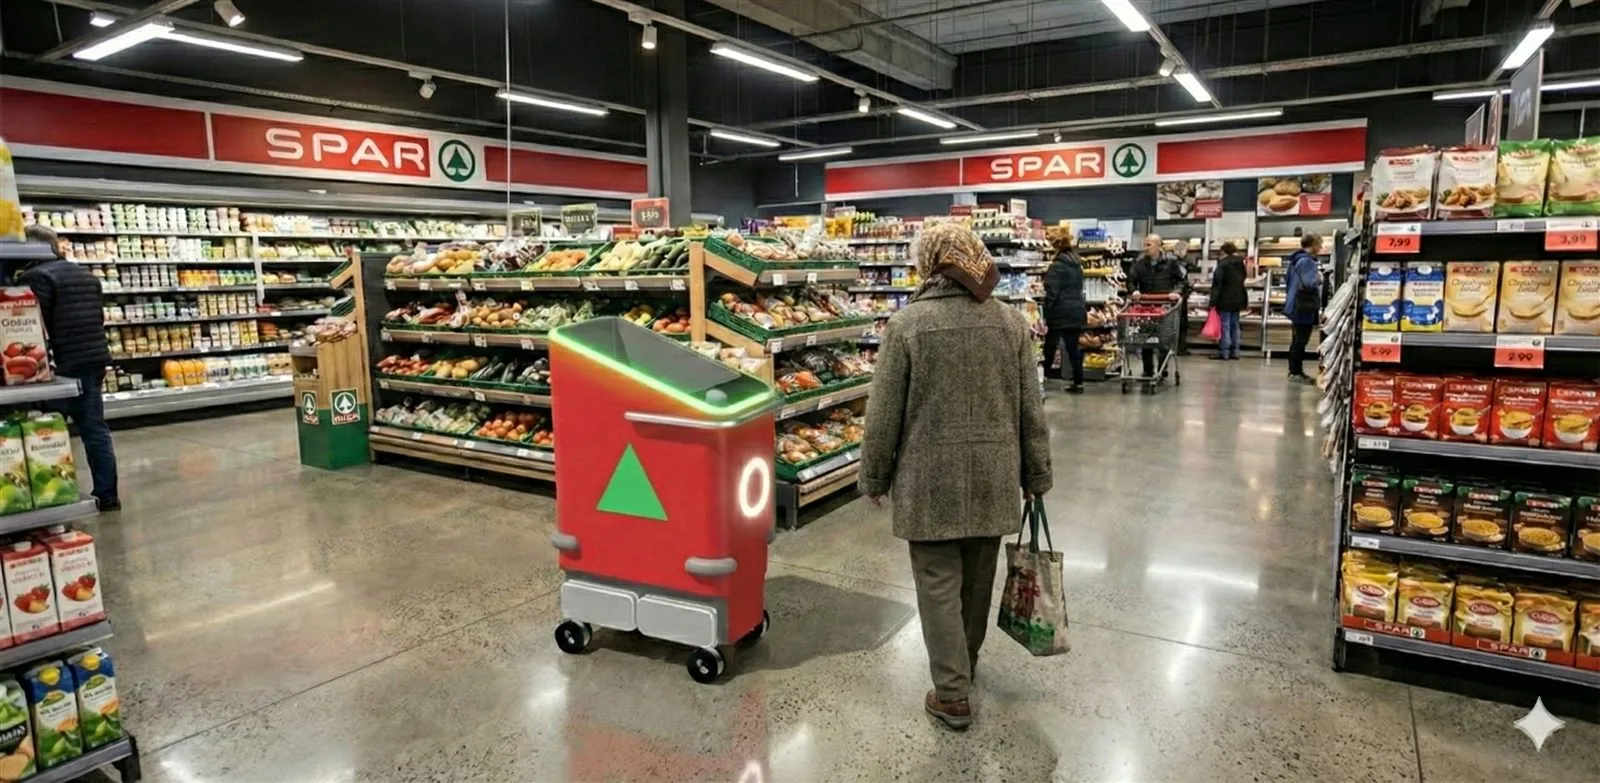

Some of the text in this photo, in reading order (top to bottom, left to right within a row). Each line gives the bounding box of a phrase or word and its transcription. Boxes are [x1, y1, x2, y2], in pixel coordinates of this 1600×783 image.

[265, 128, 425, 171] SPAR
[990, 153, 1101, 180] SPAR
[1388, 237, 1411, 247] 7,99
[1375, 621, 1410, 635] SPAR
[1490, 643, 1529, 657] SPAR
